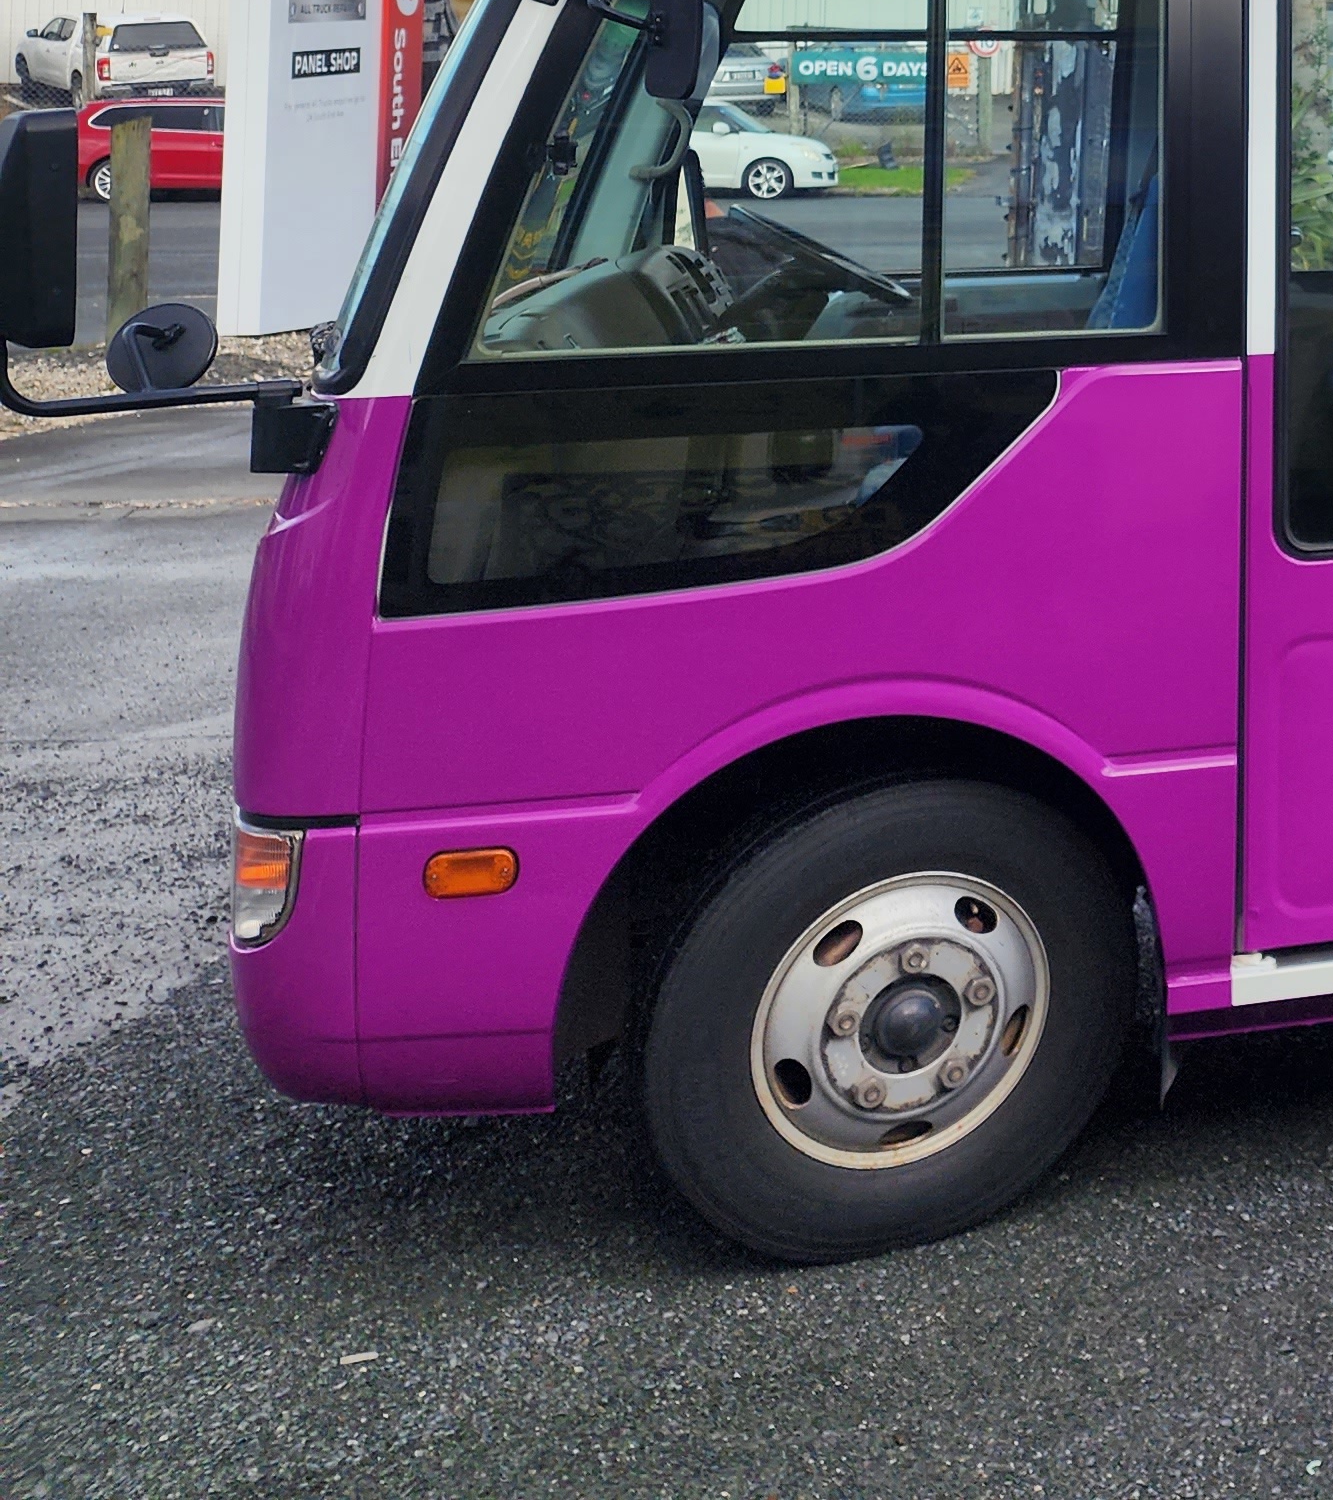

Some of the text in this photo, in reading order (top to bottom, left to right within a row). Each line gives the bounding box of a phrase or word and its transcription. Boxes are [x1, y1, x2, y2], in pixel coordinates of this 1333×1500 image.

[295, 51, 358, 75] PANEL SHOP
[799, 56, 928, 81] OPEN 6 DAYS
[391, 27, 406, 131] South
